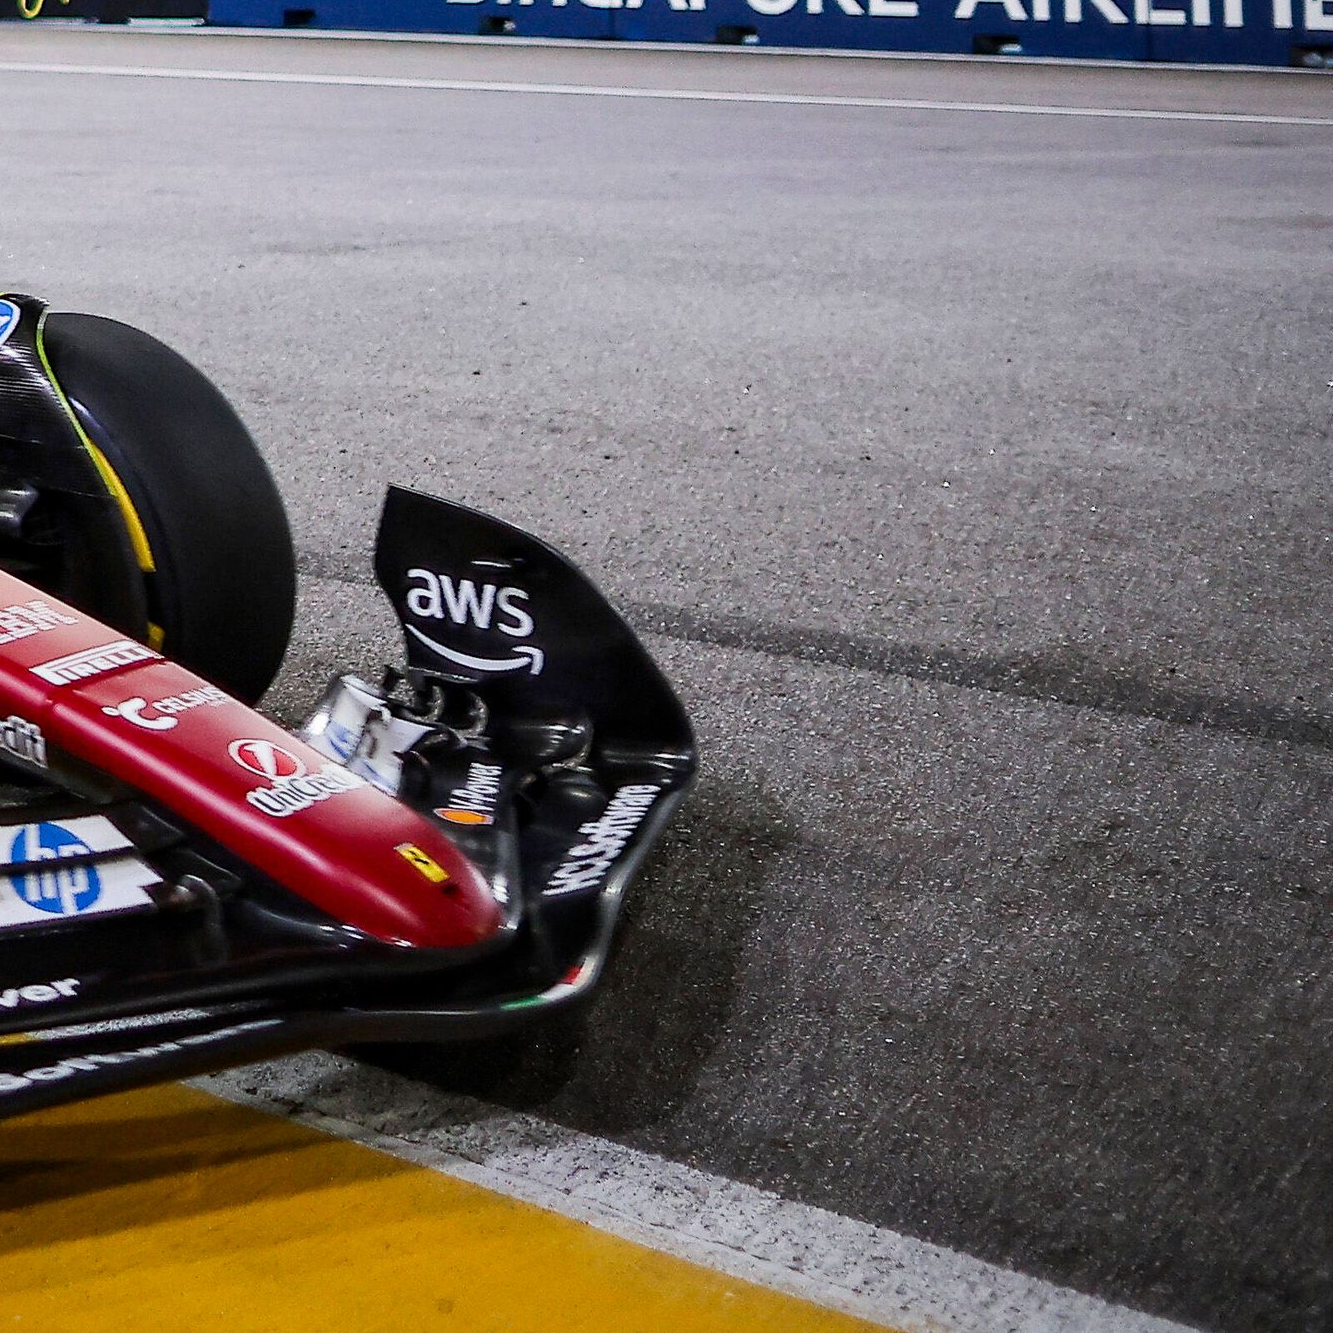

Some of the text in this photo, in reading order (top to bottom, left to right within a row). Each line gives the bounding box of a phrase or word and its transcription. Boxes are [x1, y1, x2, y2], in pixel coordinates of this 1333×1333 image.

[405, 567, 534, 639] aws
[28, 639, 165, 687] PIRELLI
[23, 822, 92, 914] hp
